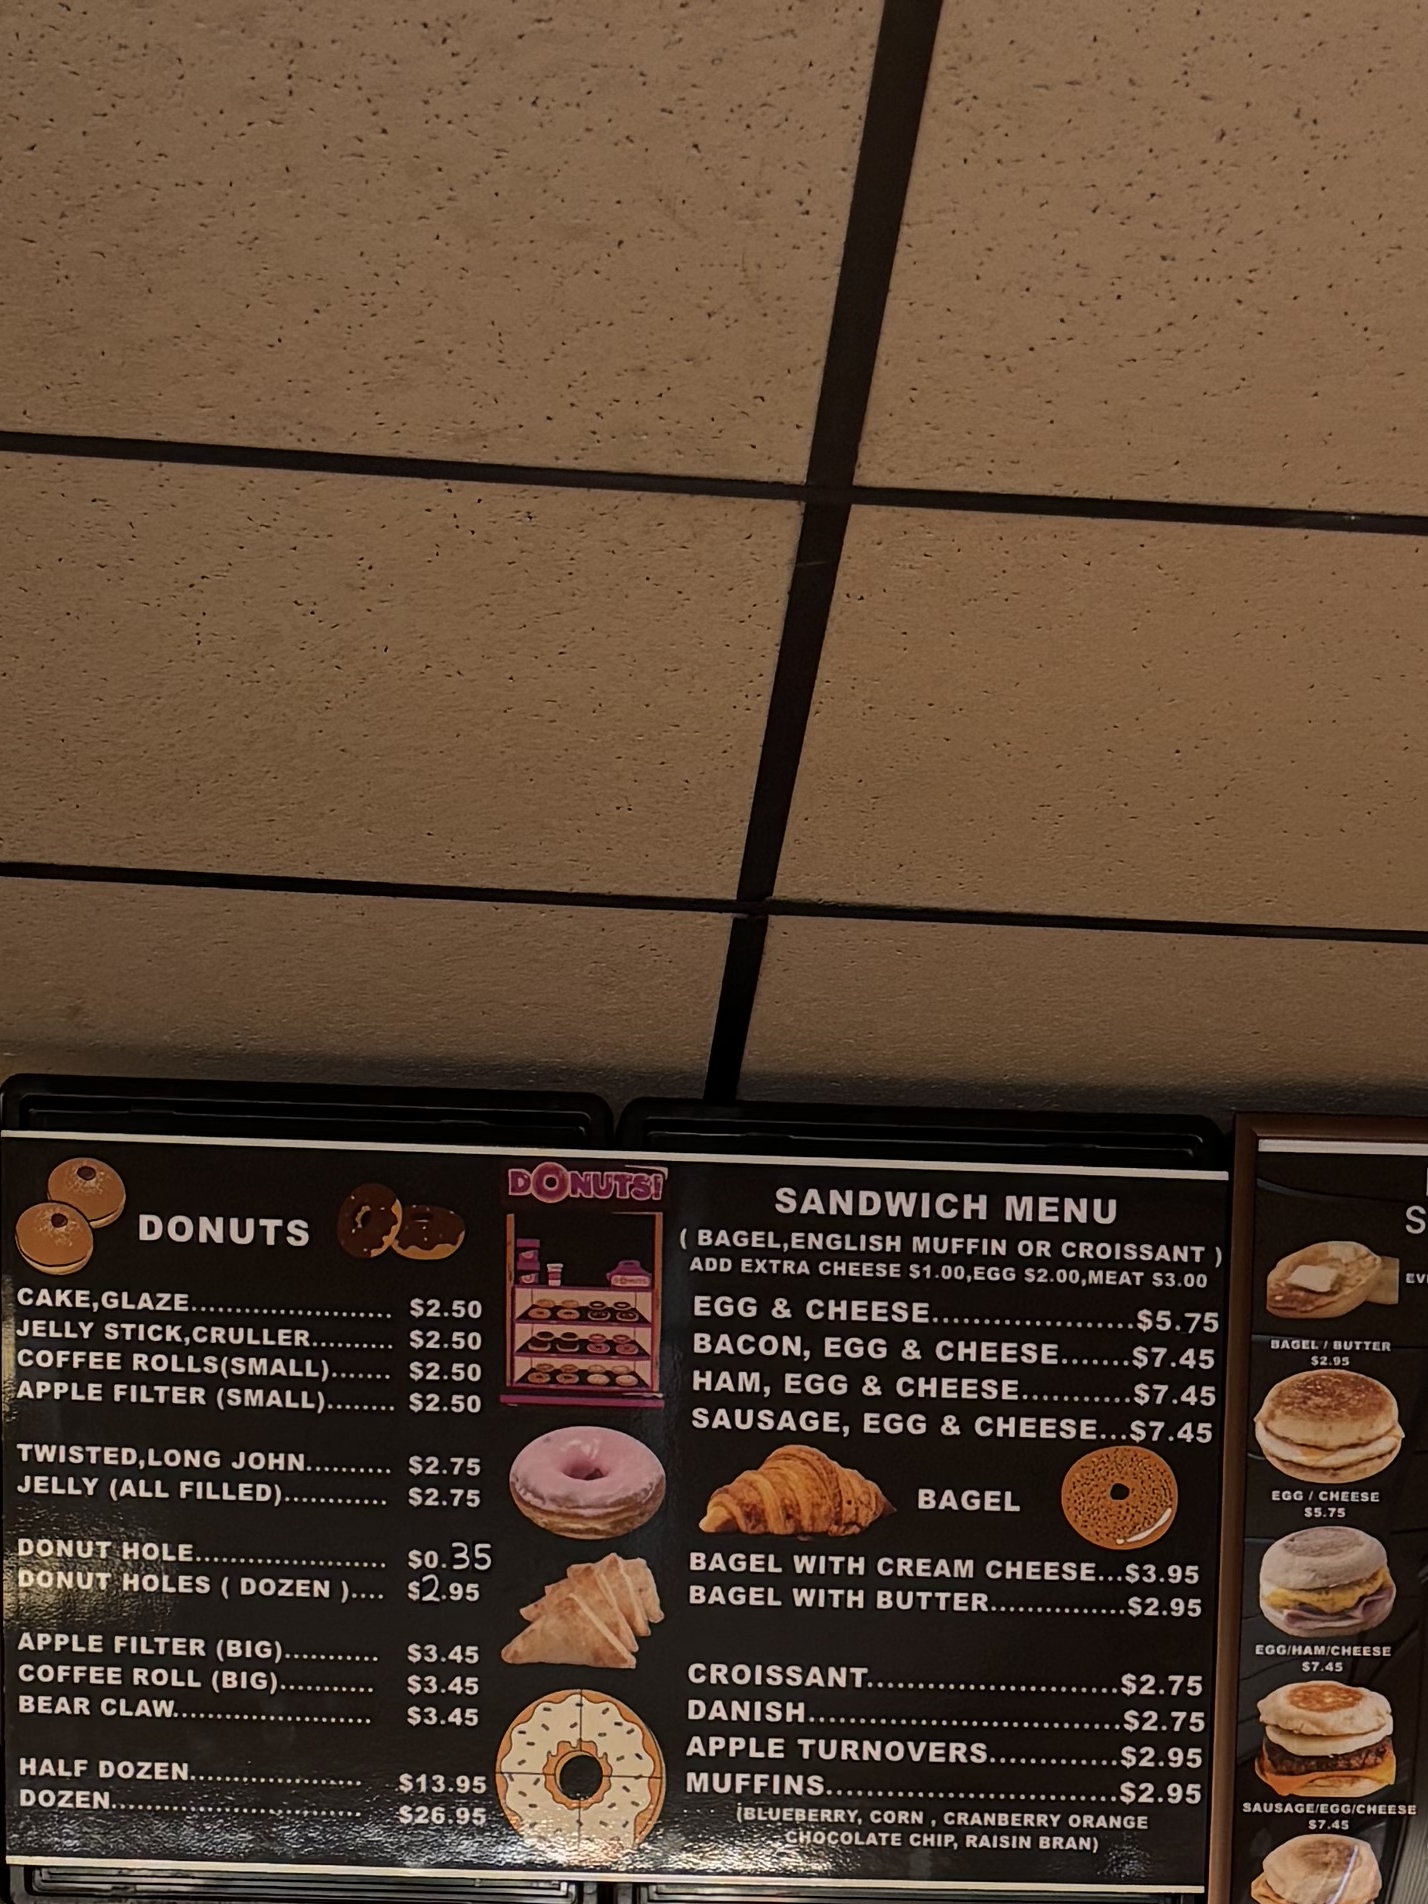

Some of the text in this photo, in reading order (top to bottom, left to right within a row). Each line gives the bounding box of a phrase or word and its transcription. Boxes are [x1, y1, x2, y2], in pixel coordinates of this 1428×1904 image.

[507, 1161, 666, 1202] DONUTS!
[775, 1187, 1118, 1226] SANDWICH MENU
[138, 1214, 310, 1247] DONUTS
[912, 1235, 1205, 1265] MUFFIN OR CROISSANT
[690, 1256, 902, 1280] ADD EXTRA CHEESE
[409, 1298, 483, 1319] $2.50
[1270, 1338, 1392, 1353] BAGEL BUTTER
[1311, 1354, 1350, 1368] $2.95
[16, 1383, 206, 1406] APPLE FILTER
[408, 1455, 481, 1477] $2.75
[918, 1489, 1020, 1513] BAGEL
[408, 1542, 492, 1570] $0.35
[407, 1708, 479, 1727] $3.45
[399, 1774, 487, 1795] $13.95
[398, 1806, 486, 1827] $26.95
